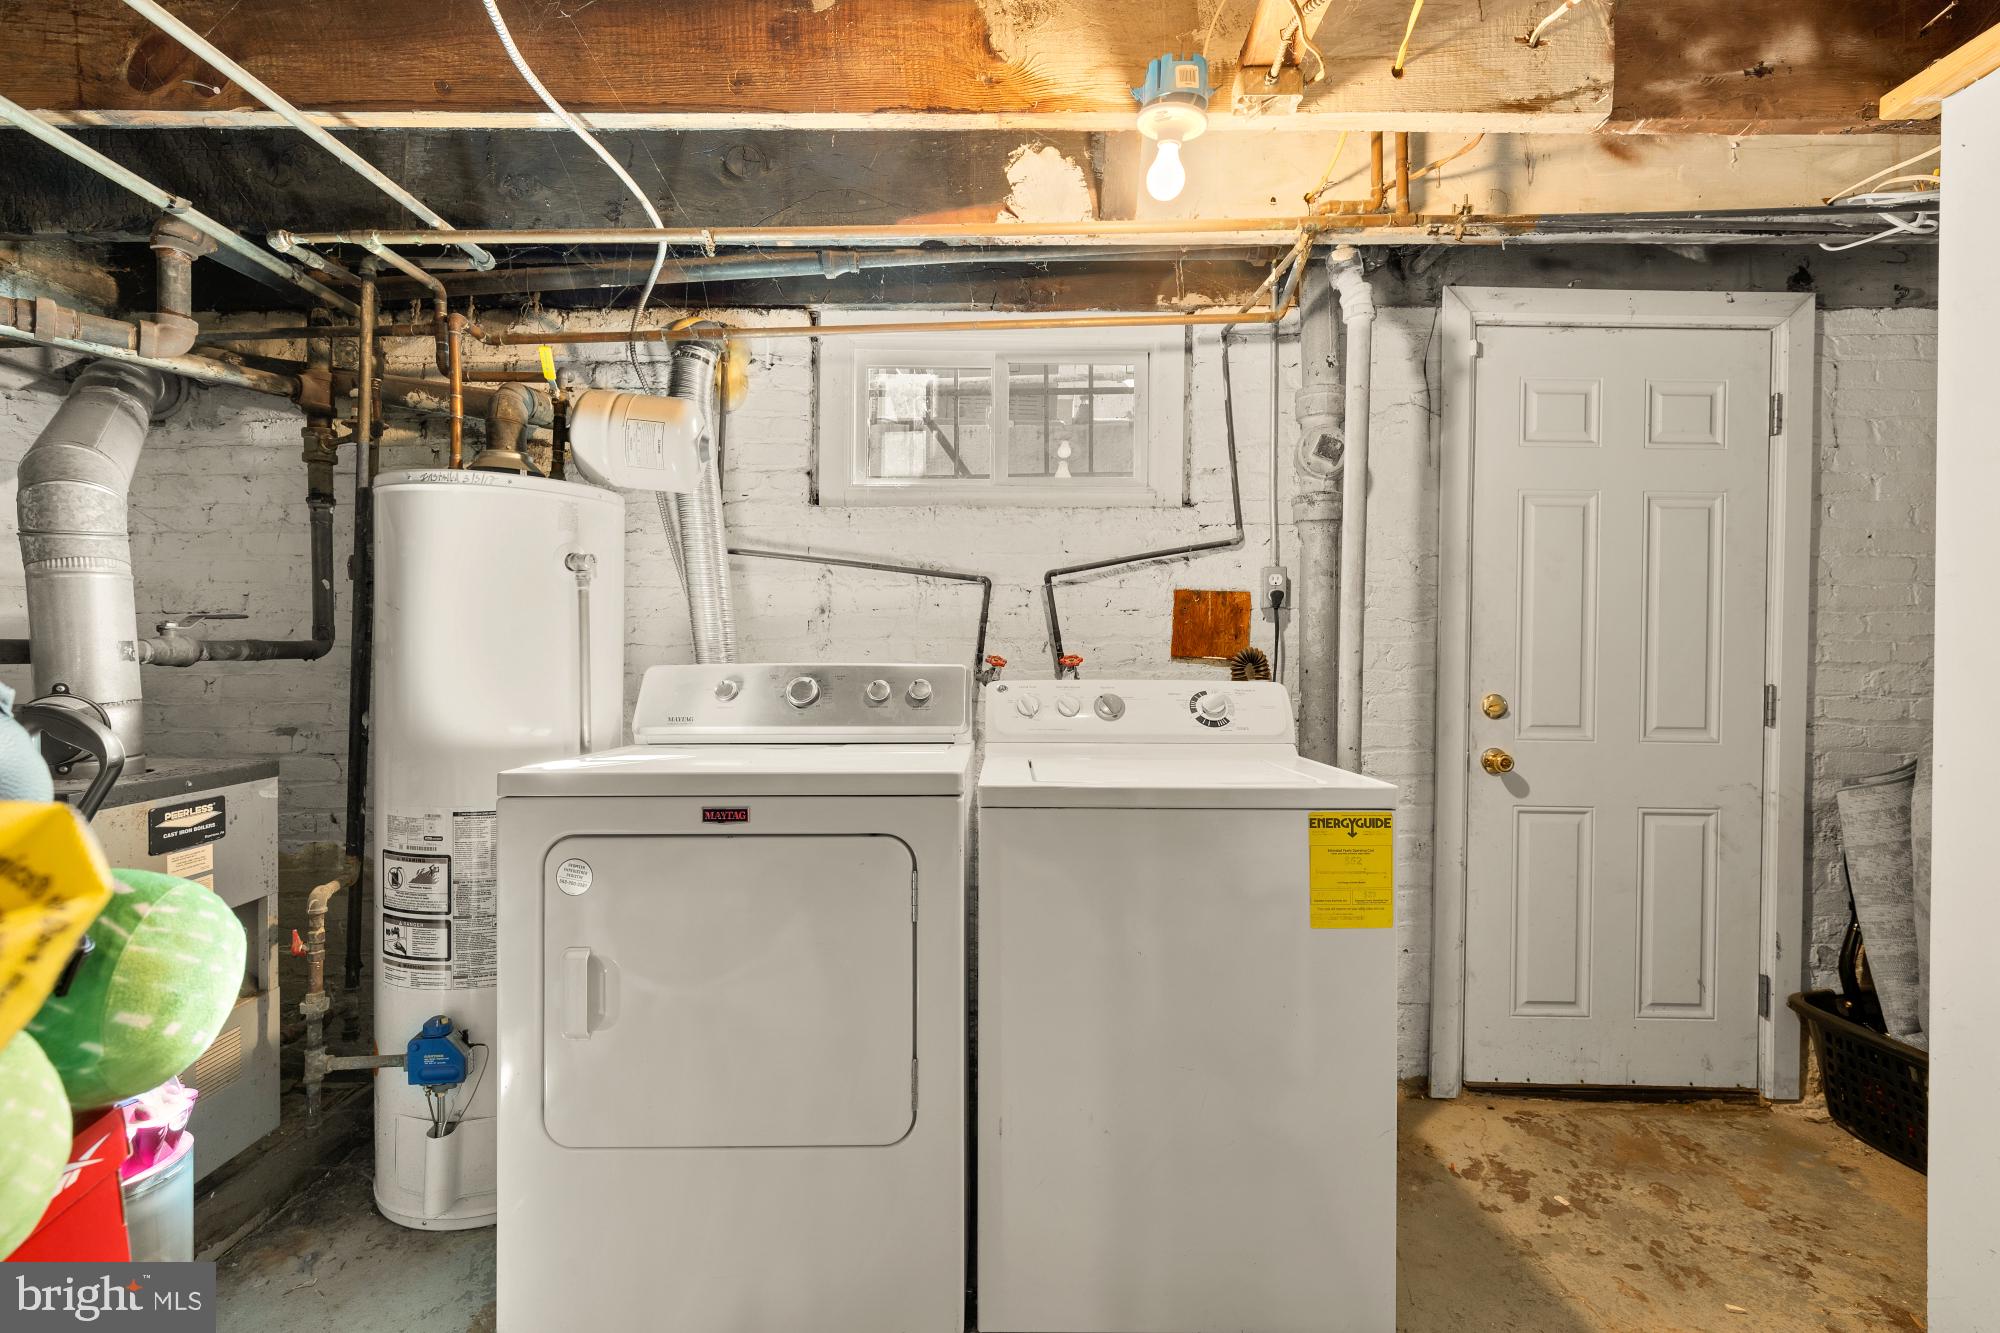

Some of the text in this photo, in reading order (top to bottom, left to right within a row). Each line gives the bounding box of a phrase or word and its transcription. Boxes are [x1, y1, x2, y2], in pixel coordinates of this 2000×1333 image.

[165, 803, 213, 821] PEERLESS
[704, 811, 746, 820] MAYTAG
[163, 822, 216, 839] CAST IRON BOILERS
